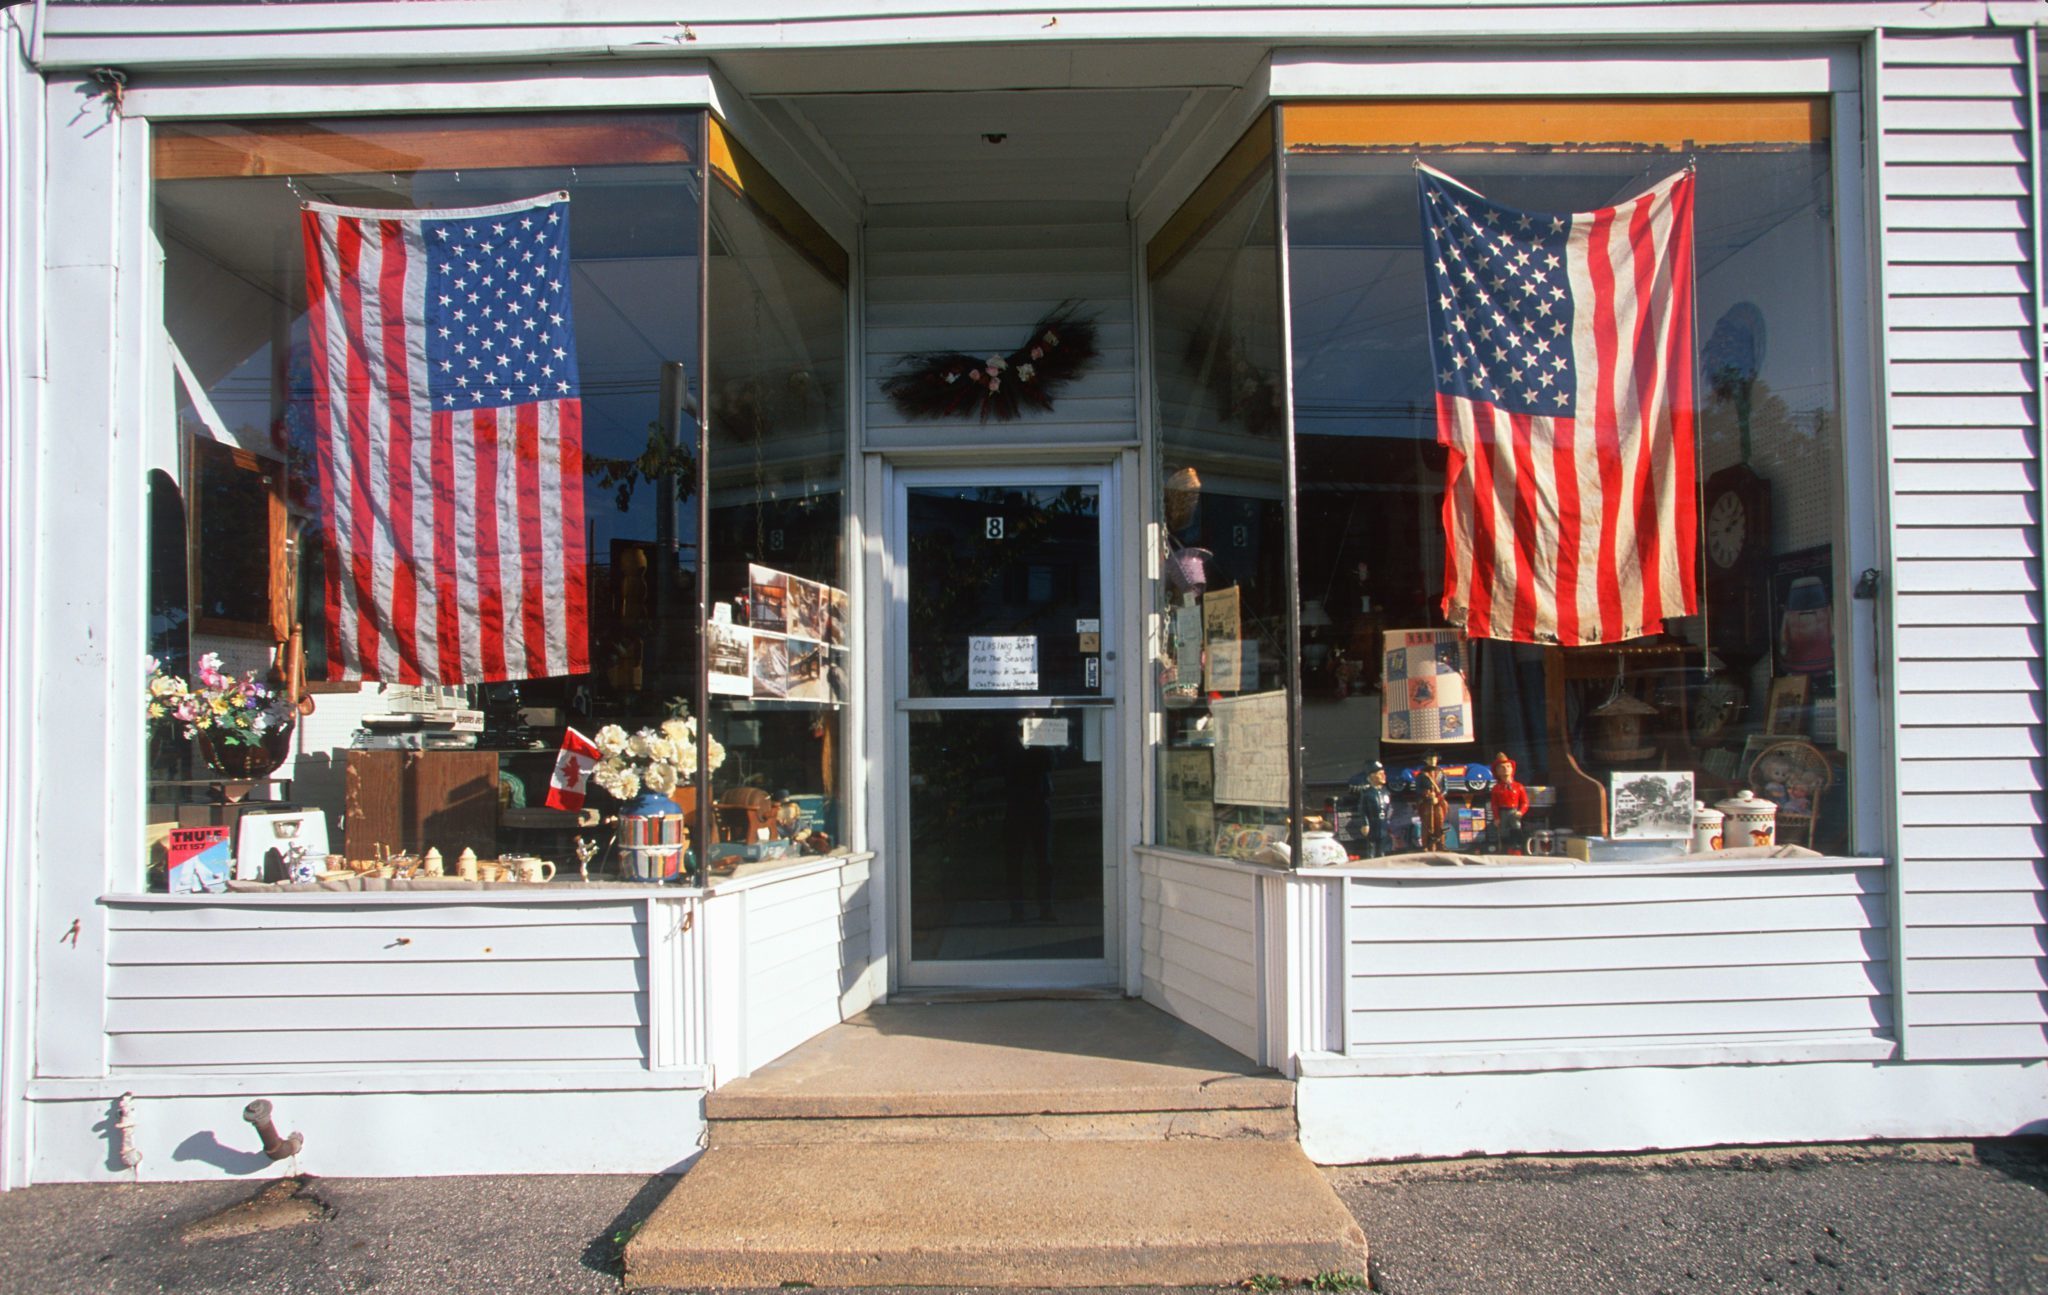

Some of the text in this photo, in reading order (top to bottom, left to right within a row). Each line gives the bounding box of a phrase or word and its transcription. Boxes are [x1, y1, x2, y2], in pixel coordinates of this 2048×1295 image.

[989, 518, 1002, 537] 8
[172, 830, 222, 843] THULE
[172, 843, 187, 851] KIT
